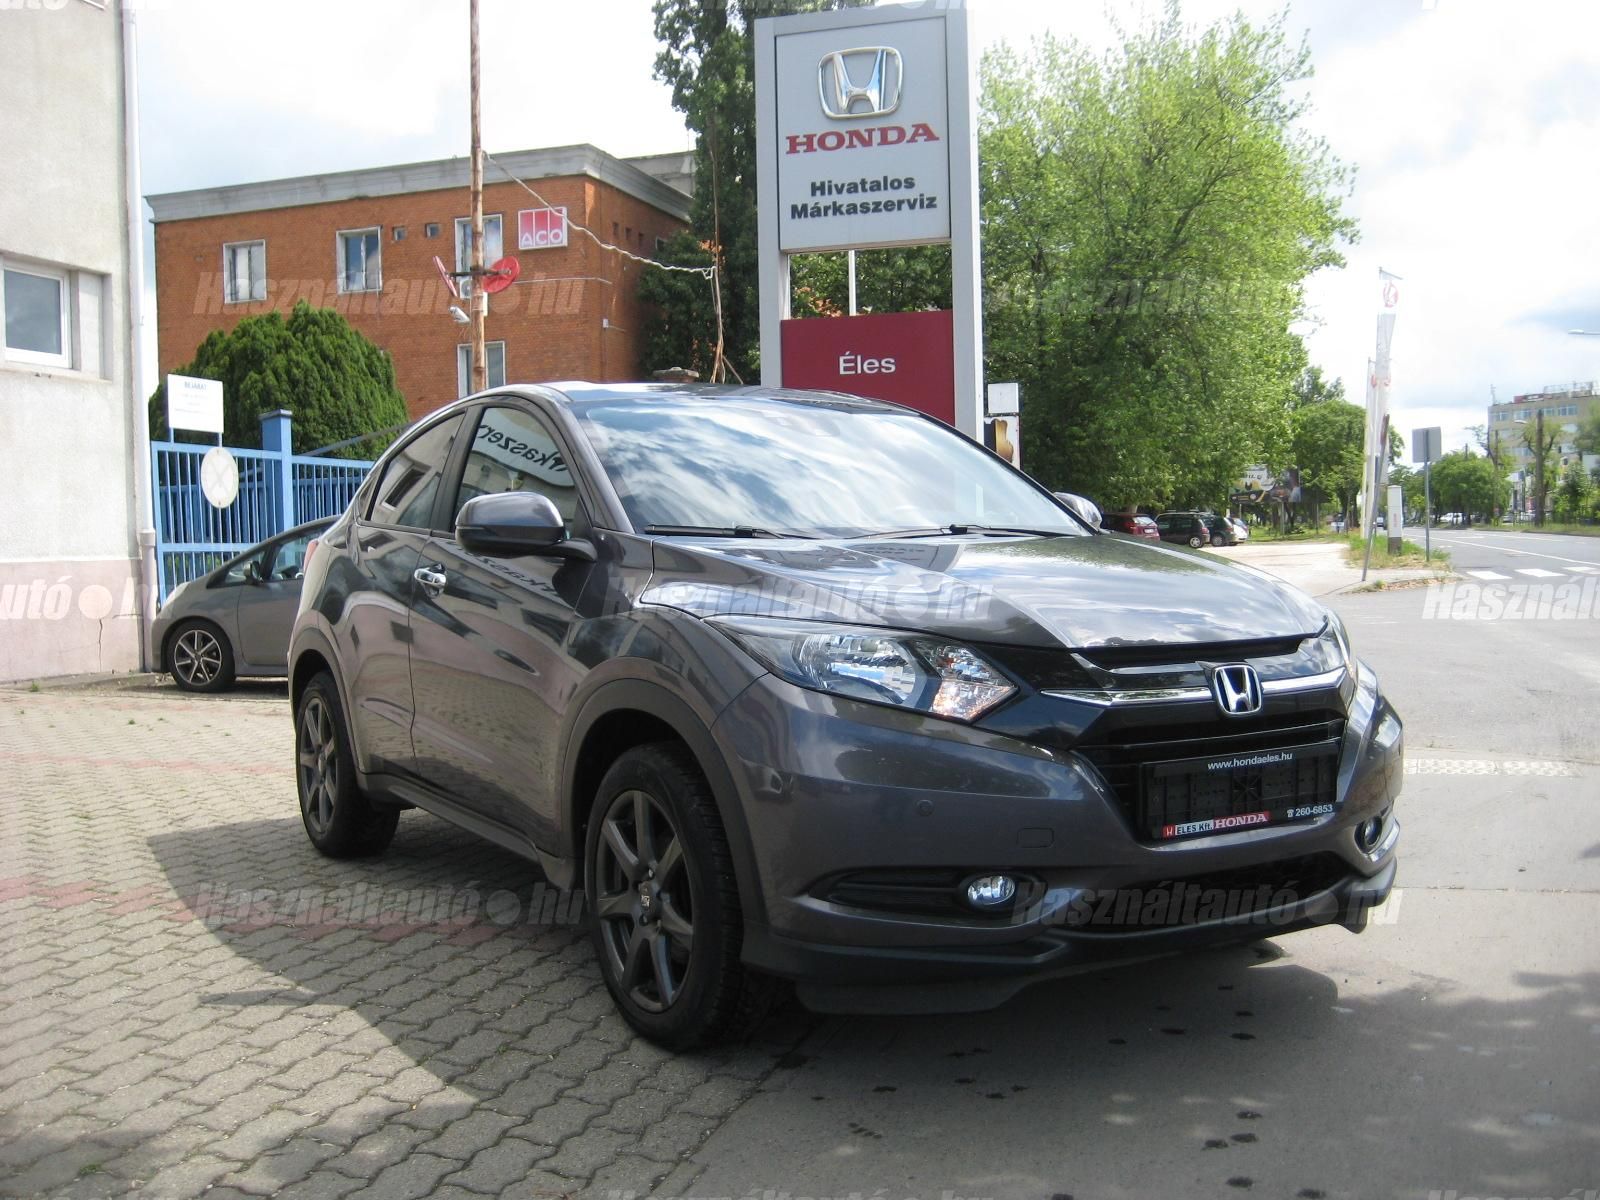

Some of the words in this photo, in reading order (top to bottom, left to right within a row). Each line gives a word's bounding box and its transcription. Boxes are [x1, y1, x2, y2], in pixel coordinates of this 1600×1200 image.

[785, 123, 940, 155] HONDA
[810, 175, 916, 197] Hivatalos
[791, 193, 938, 220] Márkaszerviz
[521, 228, 563, 247] ACO
[839, 350, 897, 375] Éles
[1207, 752, 1293, 770] www.hondaeles.hu
[1295, 804, 1333, 817] 260-6853
[1214, 813, 1268, 829] HONDA
